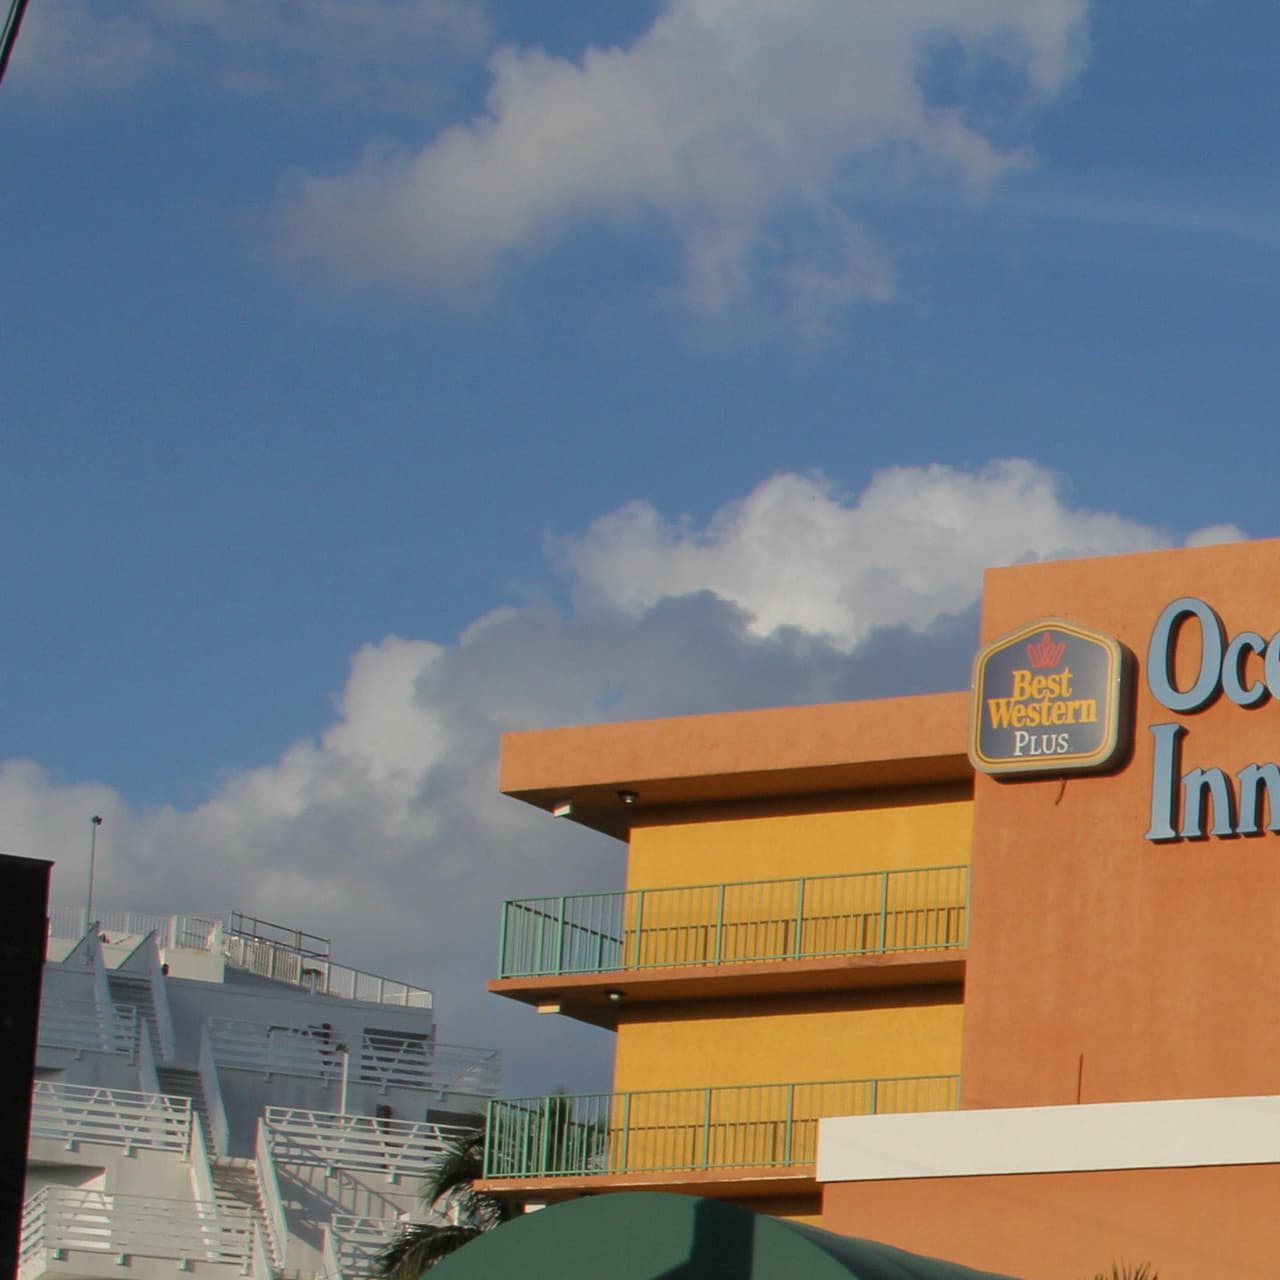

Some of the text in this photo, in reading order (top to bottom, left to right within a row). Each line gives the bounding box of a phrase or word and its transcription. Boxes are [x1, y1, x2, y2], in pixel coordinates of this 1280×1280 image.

[1011, 666, 1074, 701] Best
[987, 689, 1098, 729] Western
[1013, 730, 1069, 757] PLUS
